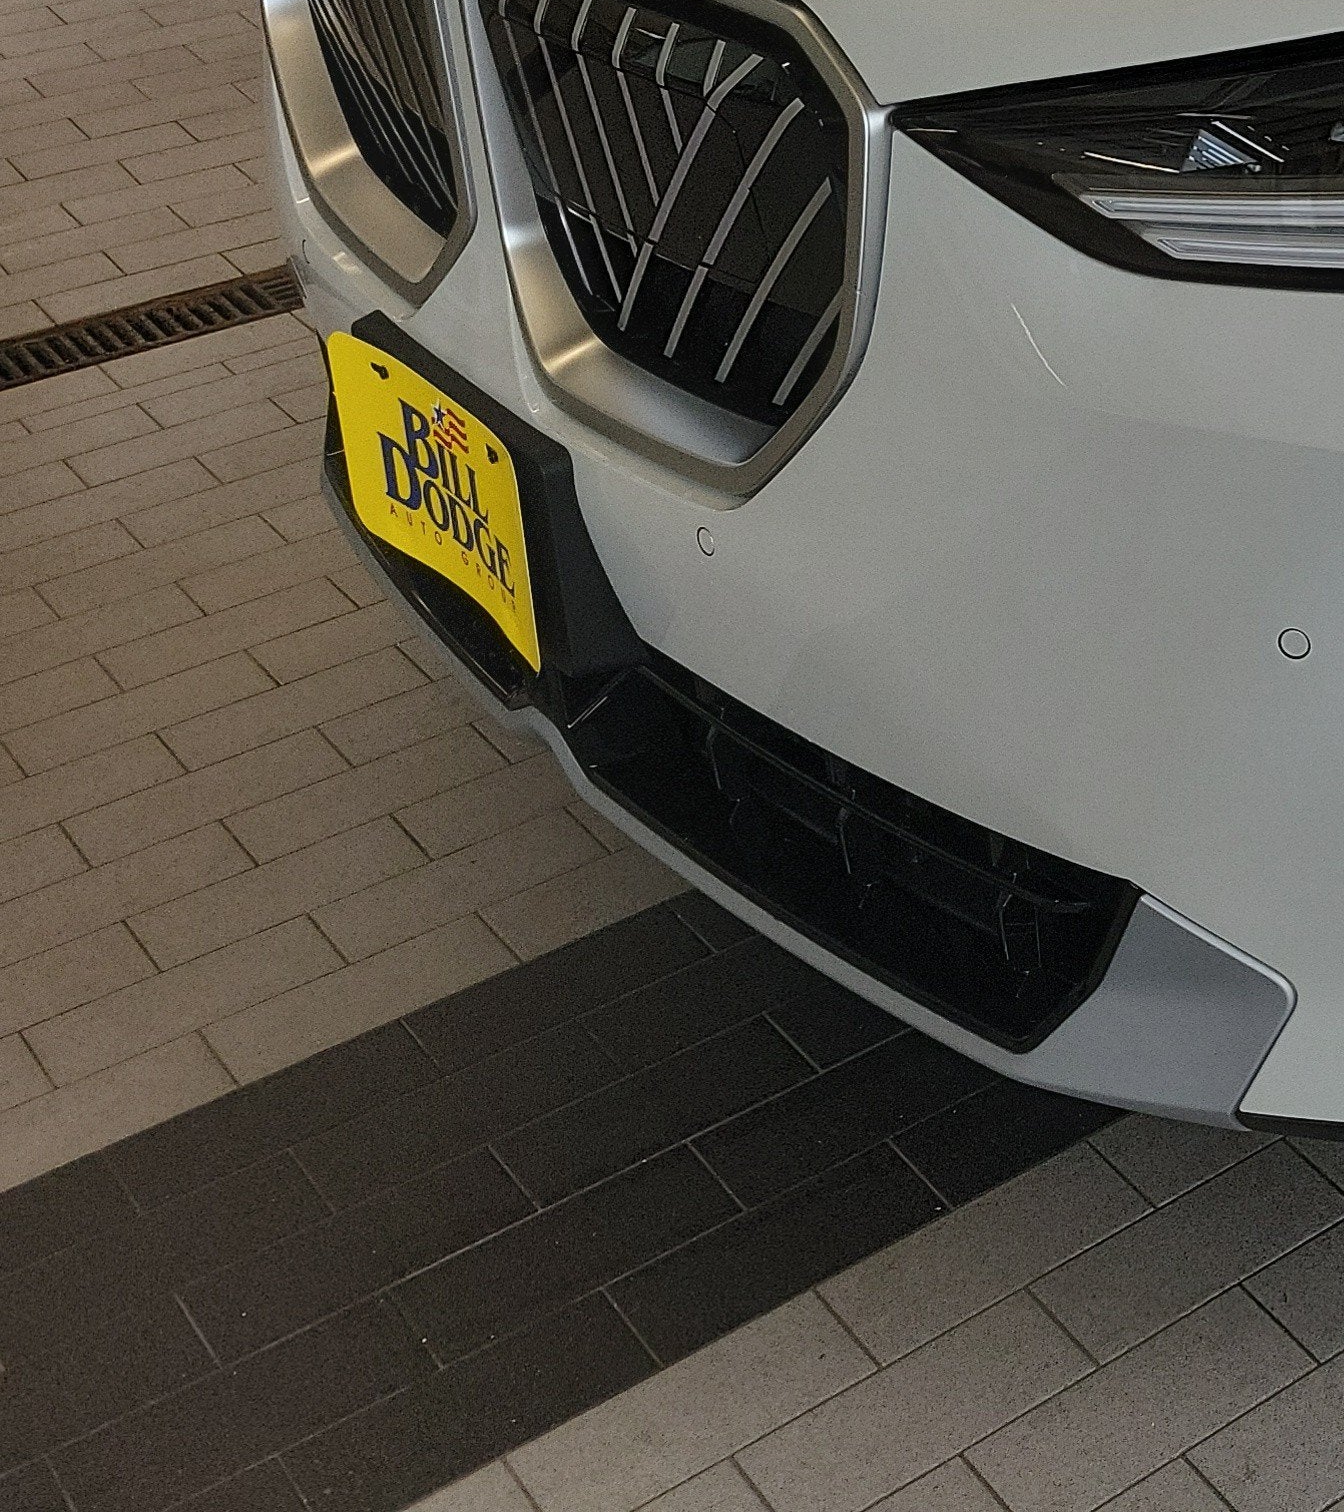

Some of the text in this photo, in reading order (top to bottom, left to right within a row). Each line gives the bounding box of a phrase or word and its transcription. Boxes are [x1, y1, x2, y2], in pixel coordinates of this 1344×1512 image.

[376, 430, 517, 599] DODGE
[388, 502, 443, 547] AUTO
[397, 397, 490, 525] BILL
